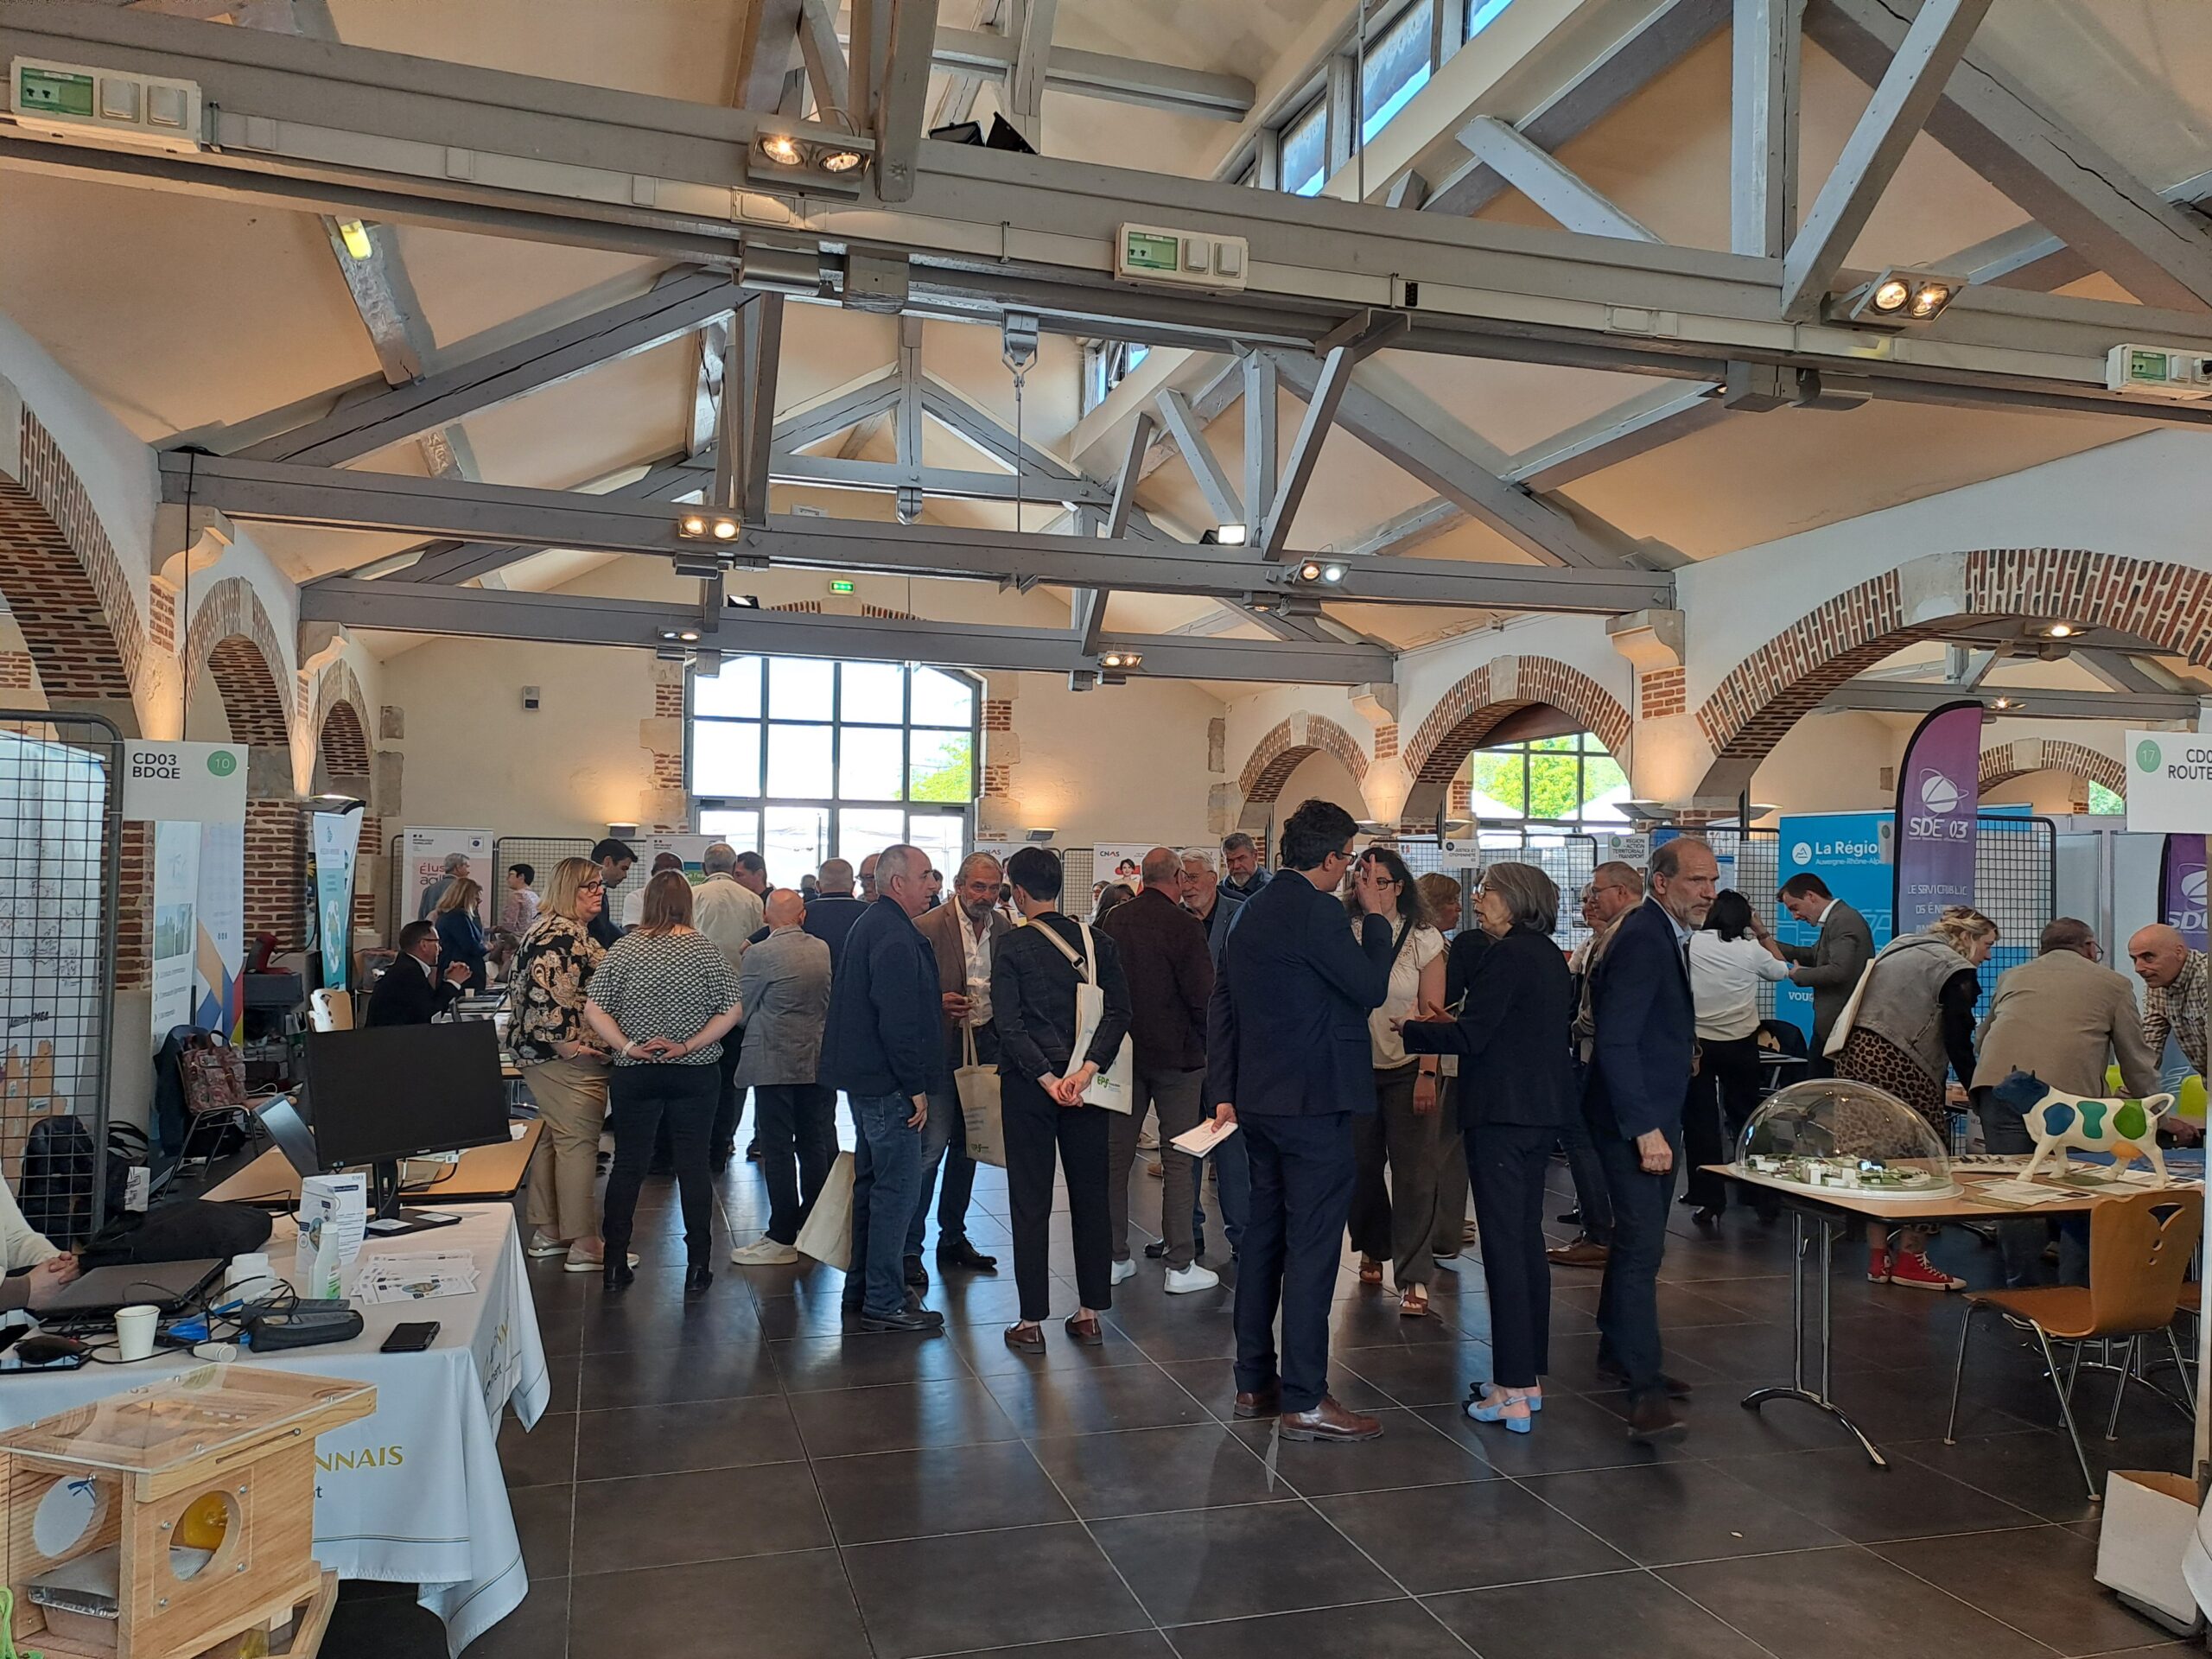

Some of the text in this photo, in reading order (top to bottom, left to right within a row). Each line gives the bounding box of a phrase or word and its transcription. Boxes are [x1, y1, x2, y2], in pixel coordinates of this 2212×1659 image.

[132, 753, 177, 766] CD03
[2142, 749, 2156, 762] 17
[215, 758, 230, 769] 10
[132, 766, 181, 779] BDQE
[1908, 817, 1969, 839] SDE 03
[1815, 842, 1832, 855] La
[419, 862, 445, 874] Élus
